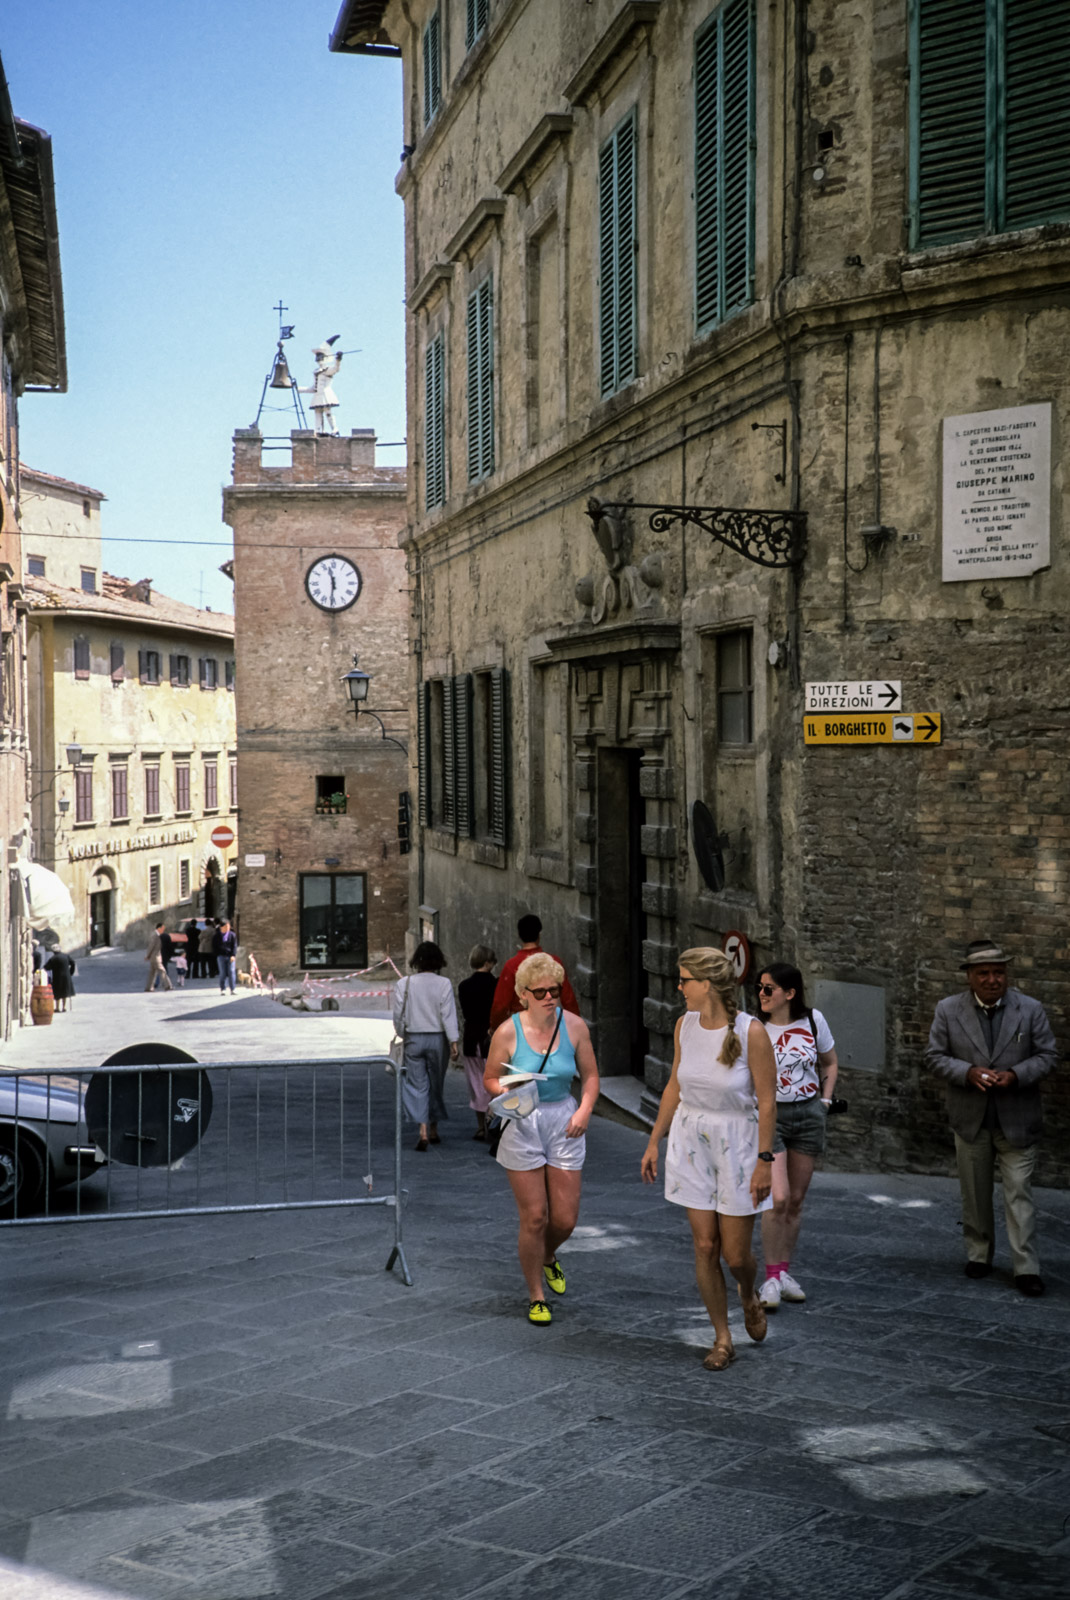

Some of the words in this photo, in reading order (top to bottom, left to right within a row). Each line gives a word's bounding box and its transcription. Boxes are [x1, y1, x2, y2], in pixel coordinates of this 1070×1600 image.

[963, 427, 991, 436] CAPESTRO
[993, 421, 1036, 432] NAZI-FASCISTA
[981, 433, 1021, 444] STRANGOLAVA
[970, 456, 998, 464] VENTENNE
[1000, 452, 1031, 462] ESISTENZA
[987, 464, 1015, 474] PATRIOTA
[956, 476, 997, 488] GIUSEPPE
[1001, 472, 1035, 484] MARINO
[987, 487, 1011, 496] CATANIA
[1001, 502, 1031, 510] TRADITORI
[1006, 512, 1026, 520] IGNAVI
[1001, 543, 1019, 552] DELLA
[958, 555, 1003, 564] MONTEPULCIANO
[810, 685, 848, 696] TUTTE
[859, 684, 873, 695] LE
[810, 697, 873, 708] DIREZIONI
[807, 724, 817, 737] IL
[824, 722, 886, 737] BORGHETTO
